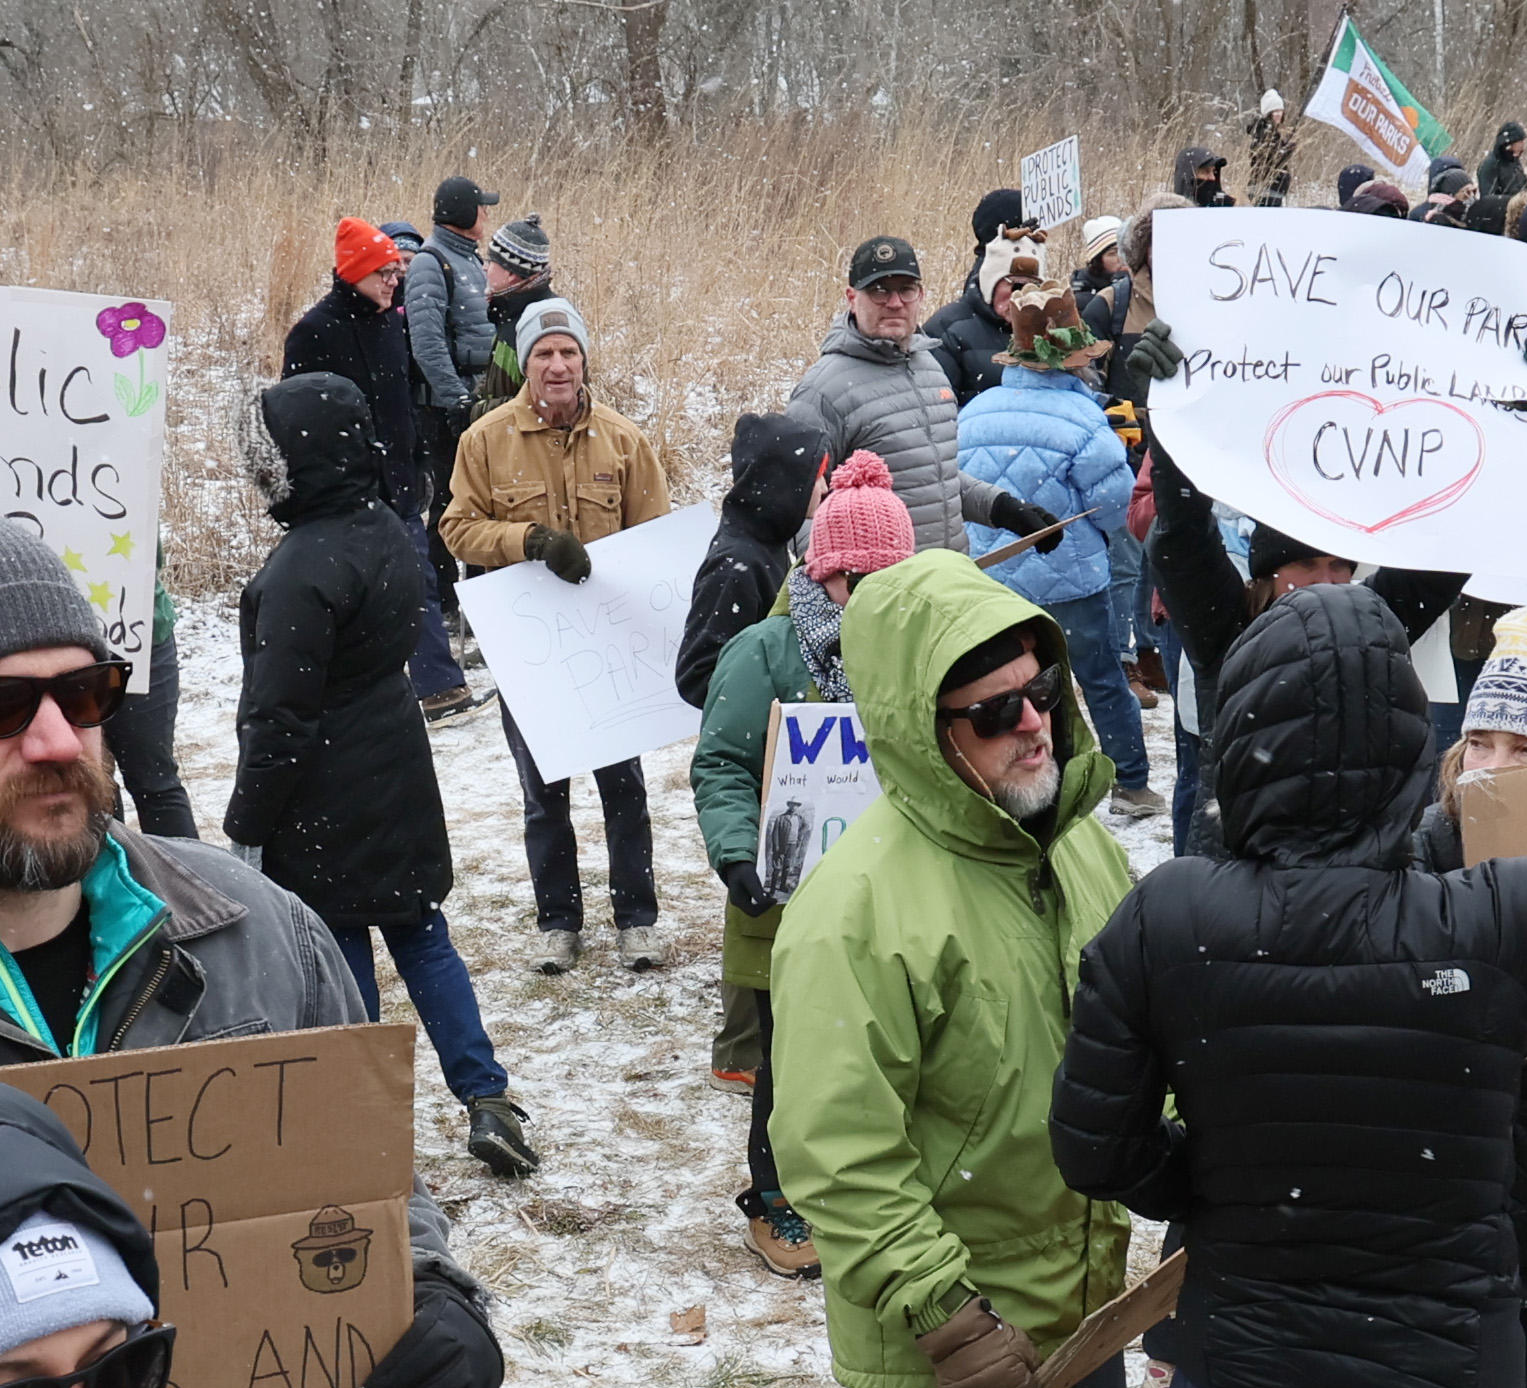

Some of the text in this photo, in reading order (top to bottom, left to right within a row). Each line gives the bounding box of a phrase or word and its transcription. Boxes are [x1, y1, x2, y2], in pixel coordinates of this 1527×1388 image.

[1349, 93, 1411, 155] OUR PARKS
[1028, 139, 1074, 181] PROTECT
[1024, 169, 1069, 208] PUBLIC
[1209, 239, 1337, 306] SAVE
[1376, 271, 1450, 330] OUR
[1320, 363, 1362, 386] our
[1370, 353, 1442, 397] Public
[1312, 420, 1444, 482] CVNP
[512, 575, 693, 666] SAVE OU
[1422, 977, 1455, 989] NORTH
[1430, 985, 1455, 996] FACE
[1434, 968, 1454, 979] THE
[44, 1056, 317, 1166] OTECT
[12, 1234, 79, 1260] teton
